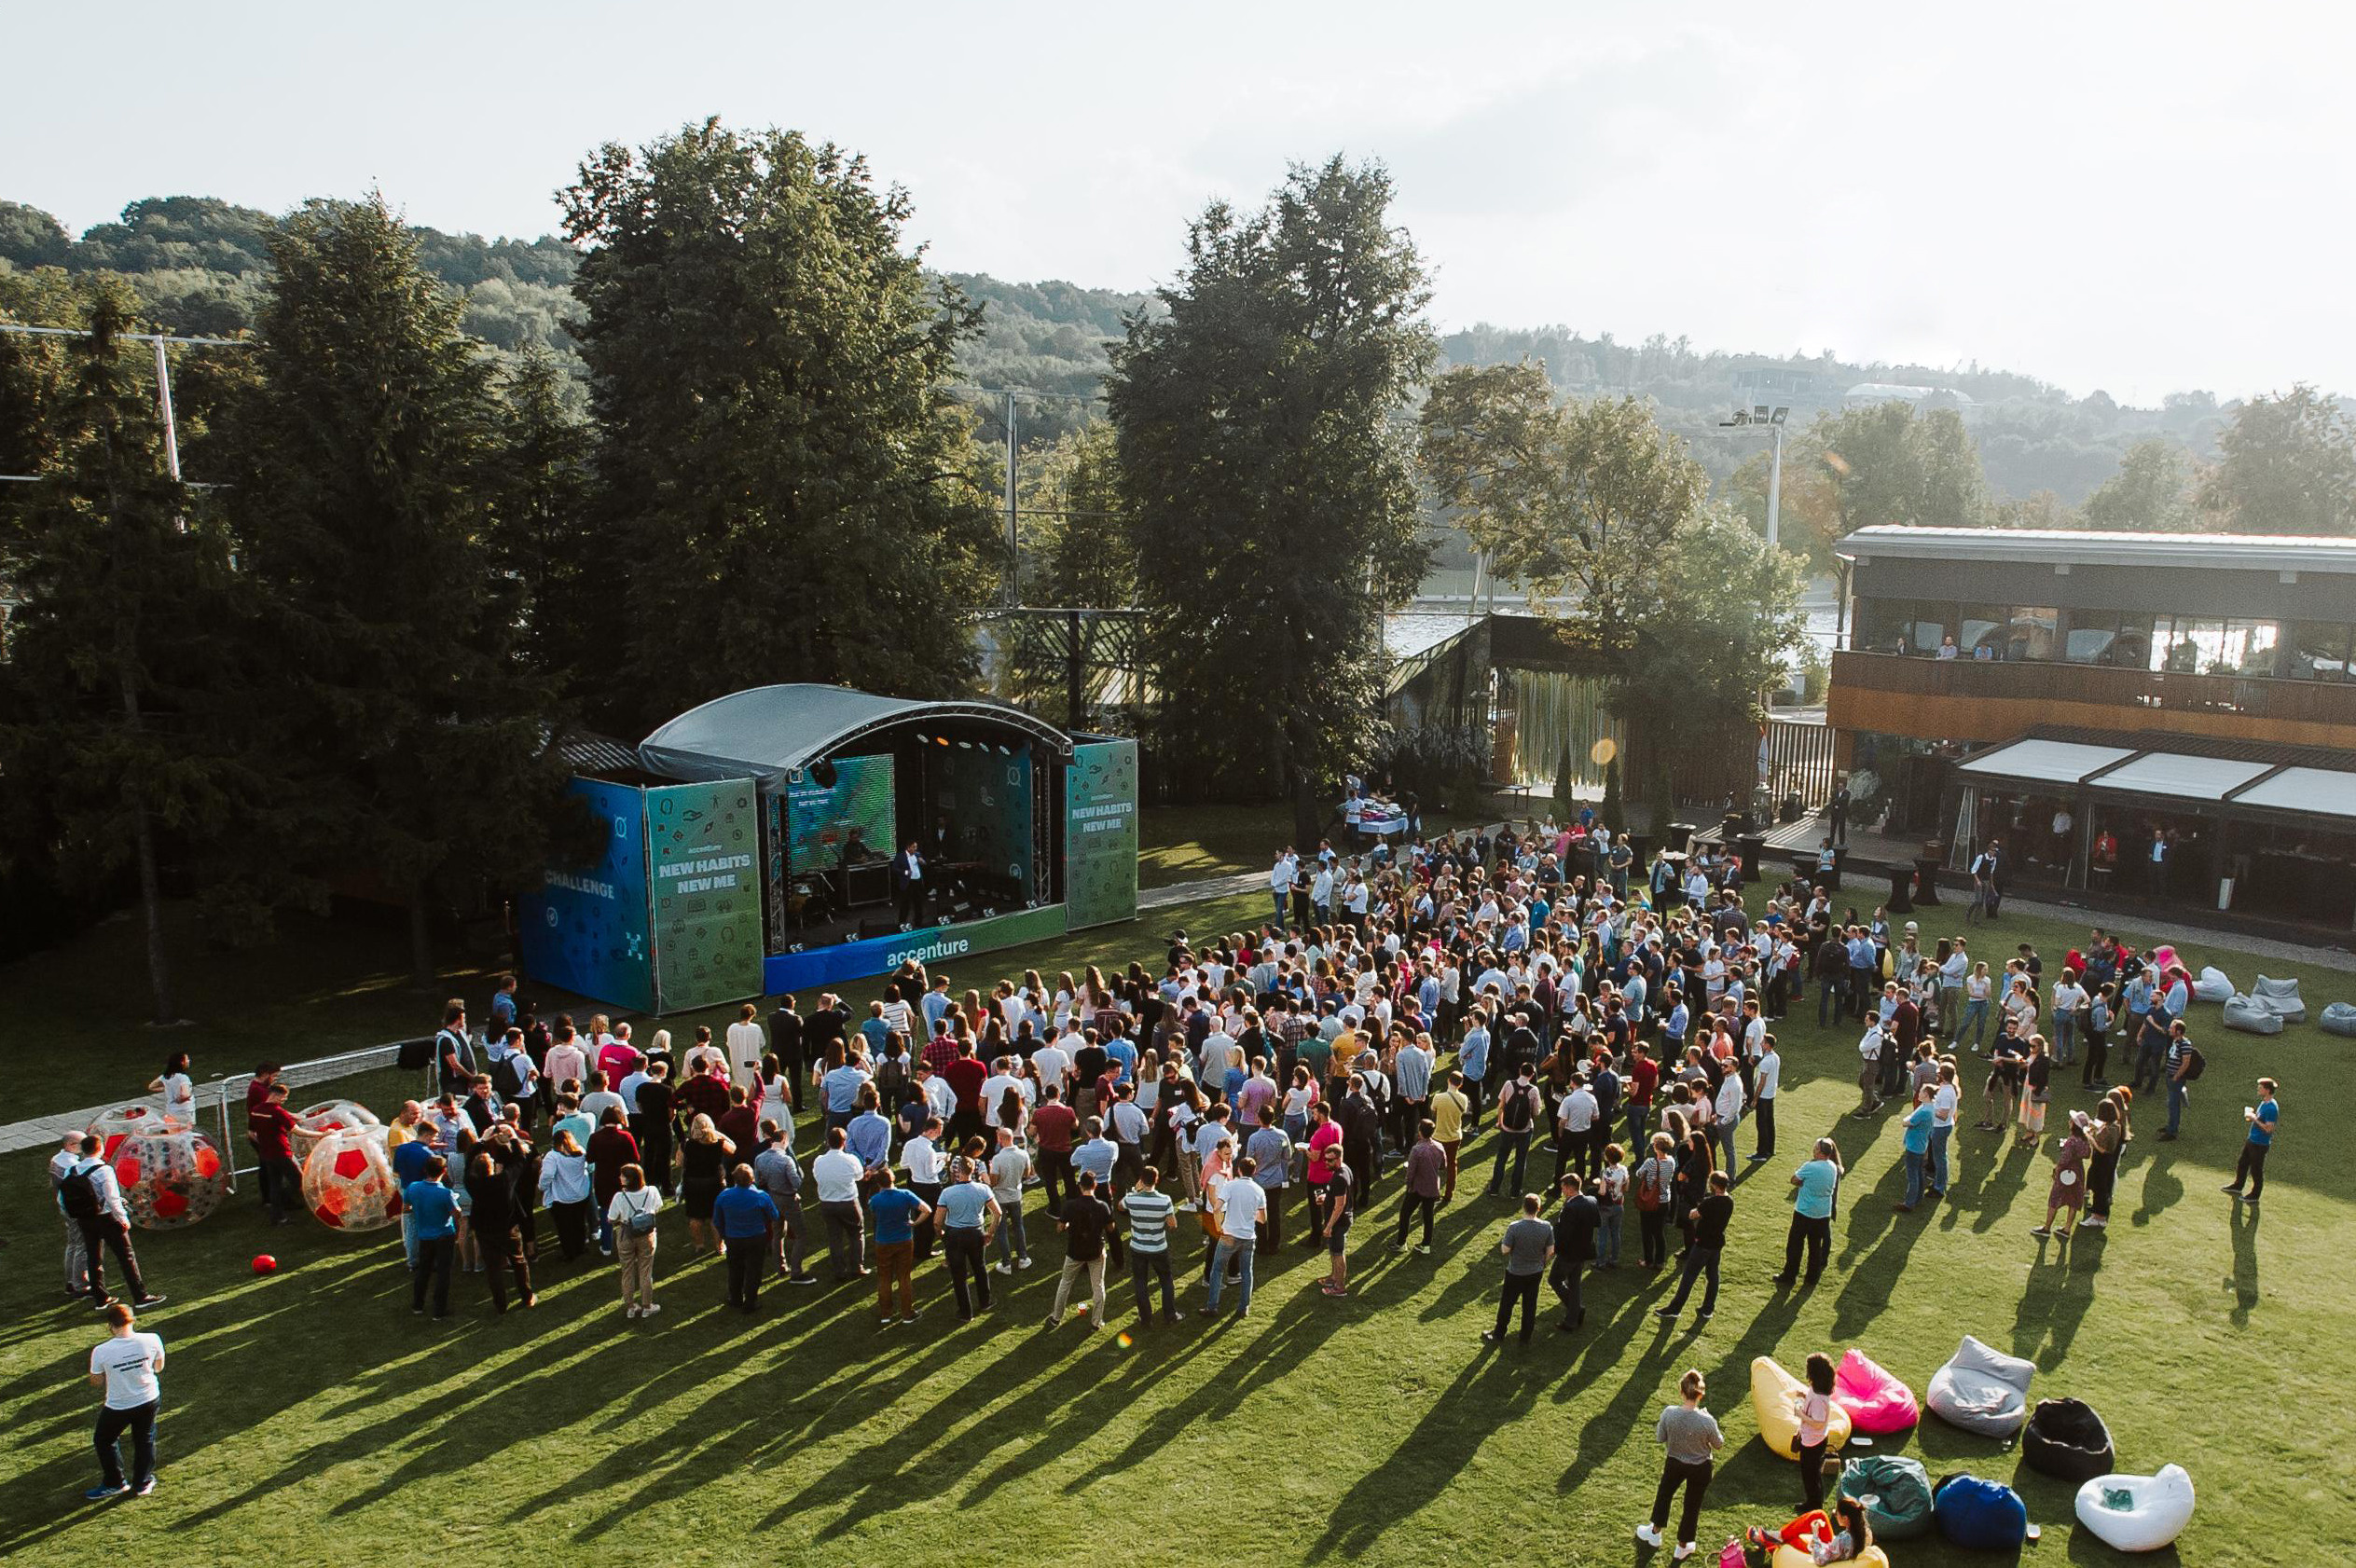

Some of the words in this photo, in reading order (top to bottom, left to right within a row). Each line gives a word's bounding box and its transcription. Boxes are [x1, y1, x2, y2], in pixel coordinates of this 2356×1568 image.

[1072, 806, 1095, 819] NEW
[1096, 803, 1132, 817] HABITS
[1083, 820, 1106, 833] NEW
[1107, 818, 1122, 830] ME
[659, 861, 695, 878] NEW
[696, 855, 751, 873] HABITS
[544, 869, 614, 900] CHALLENGE
[677, 877, 712, 894] NEW
[713, 874, 736, 888] ME
[887, 939, 969, 967] accenture
